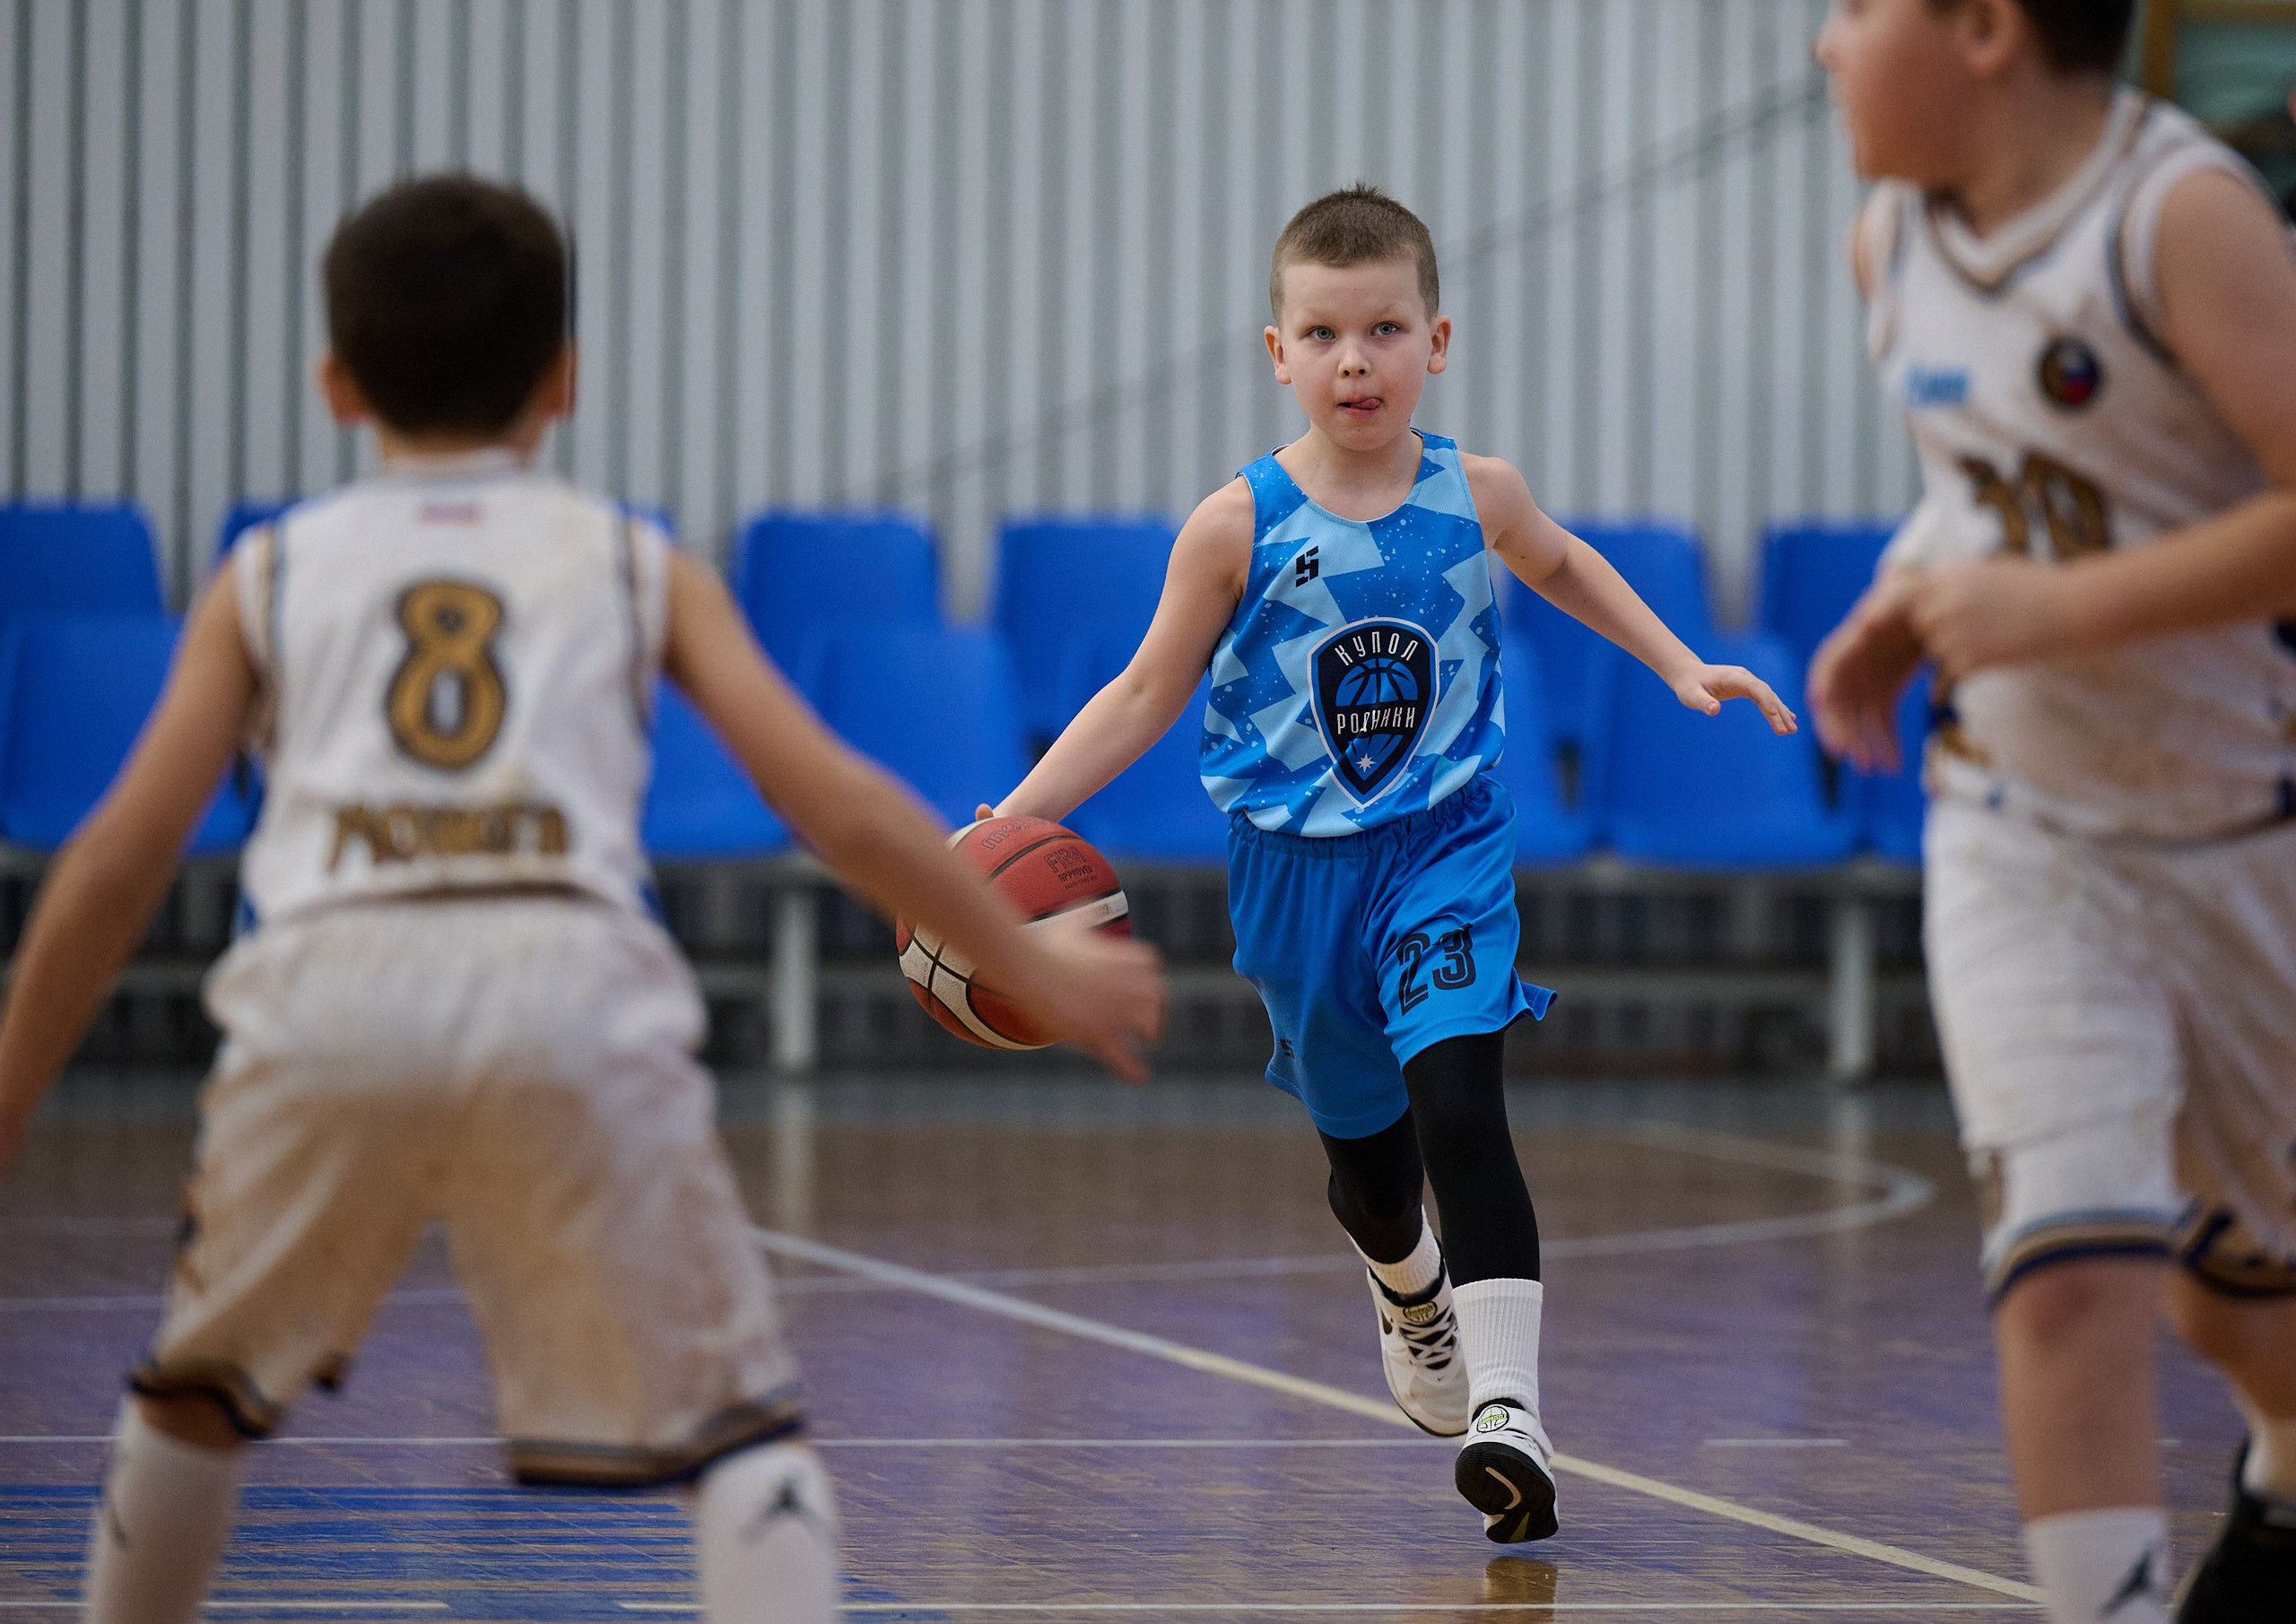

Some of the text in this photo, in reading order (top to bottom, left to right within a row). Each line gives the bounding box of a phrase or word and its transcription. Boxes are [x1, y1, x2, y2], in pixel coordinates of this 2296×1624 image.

[1335, 631, 1418, 665] КУПОЛ
[386, 579, 507, 769] 8
[1337, 708, 1415, 734] РОДНИКИ
[1044, 847, 1087, 873] FIBA
[1396, 923, 1476, 1015] 23
